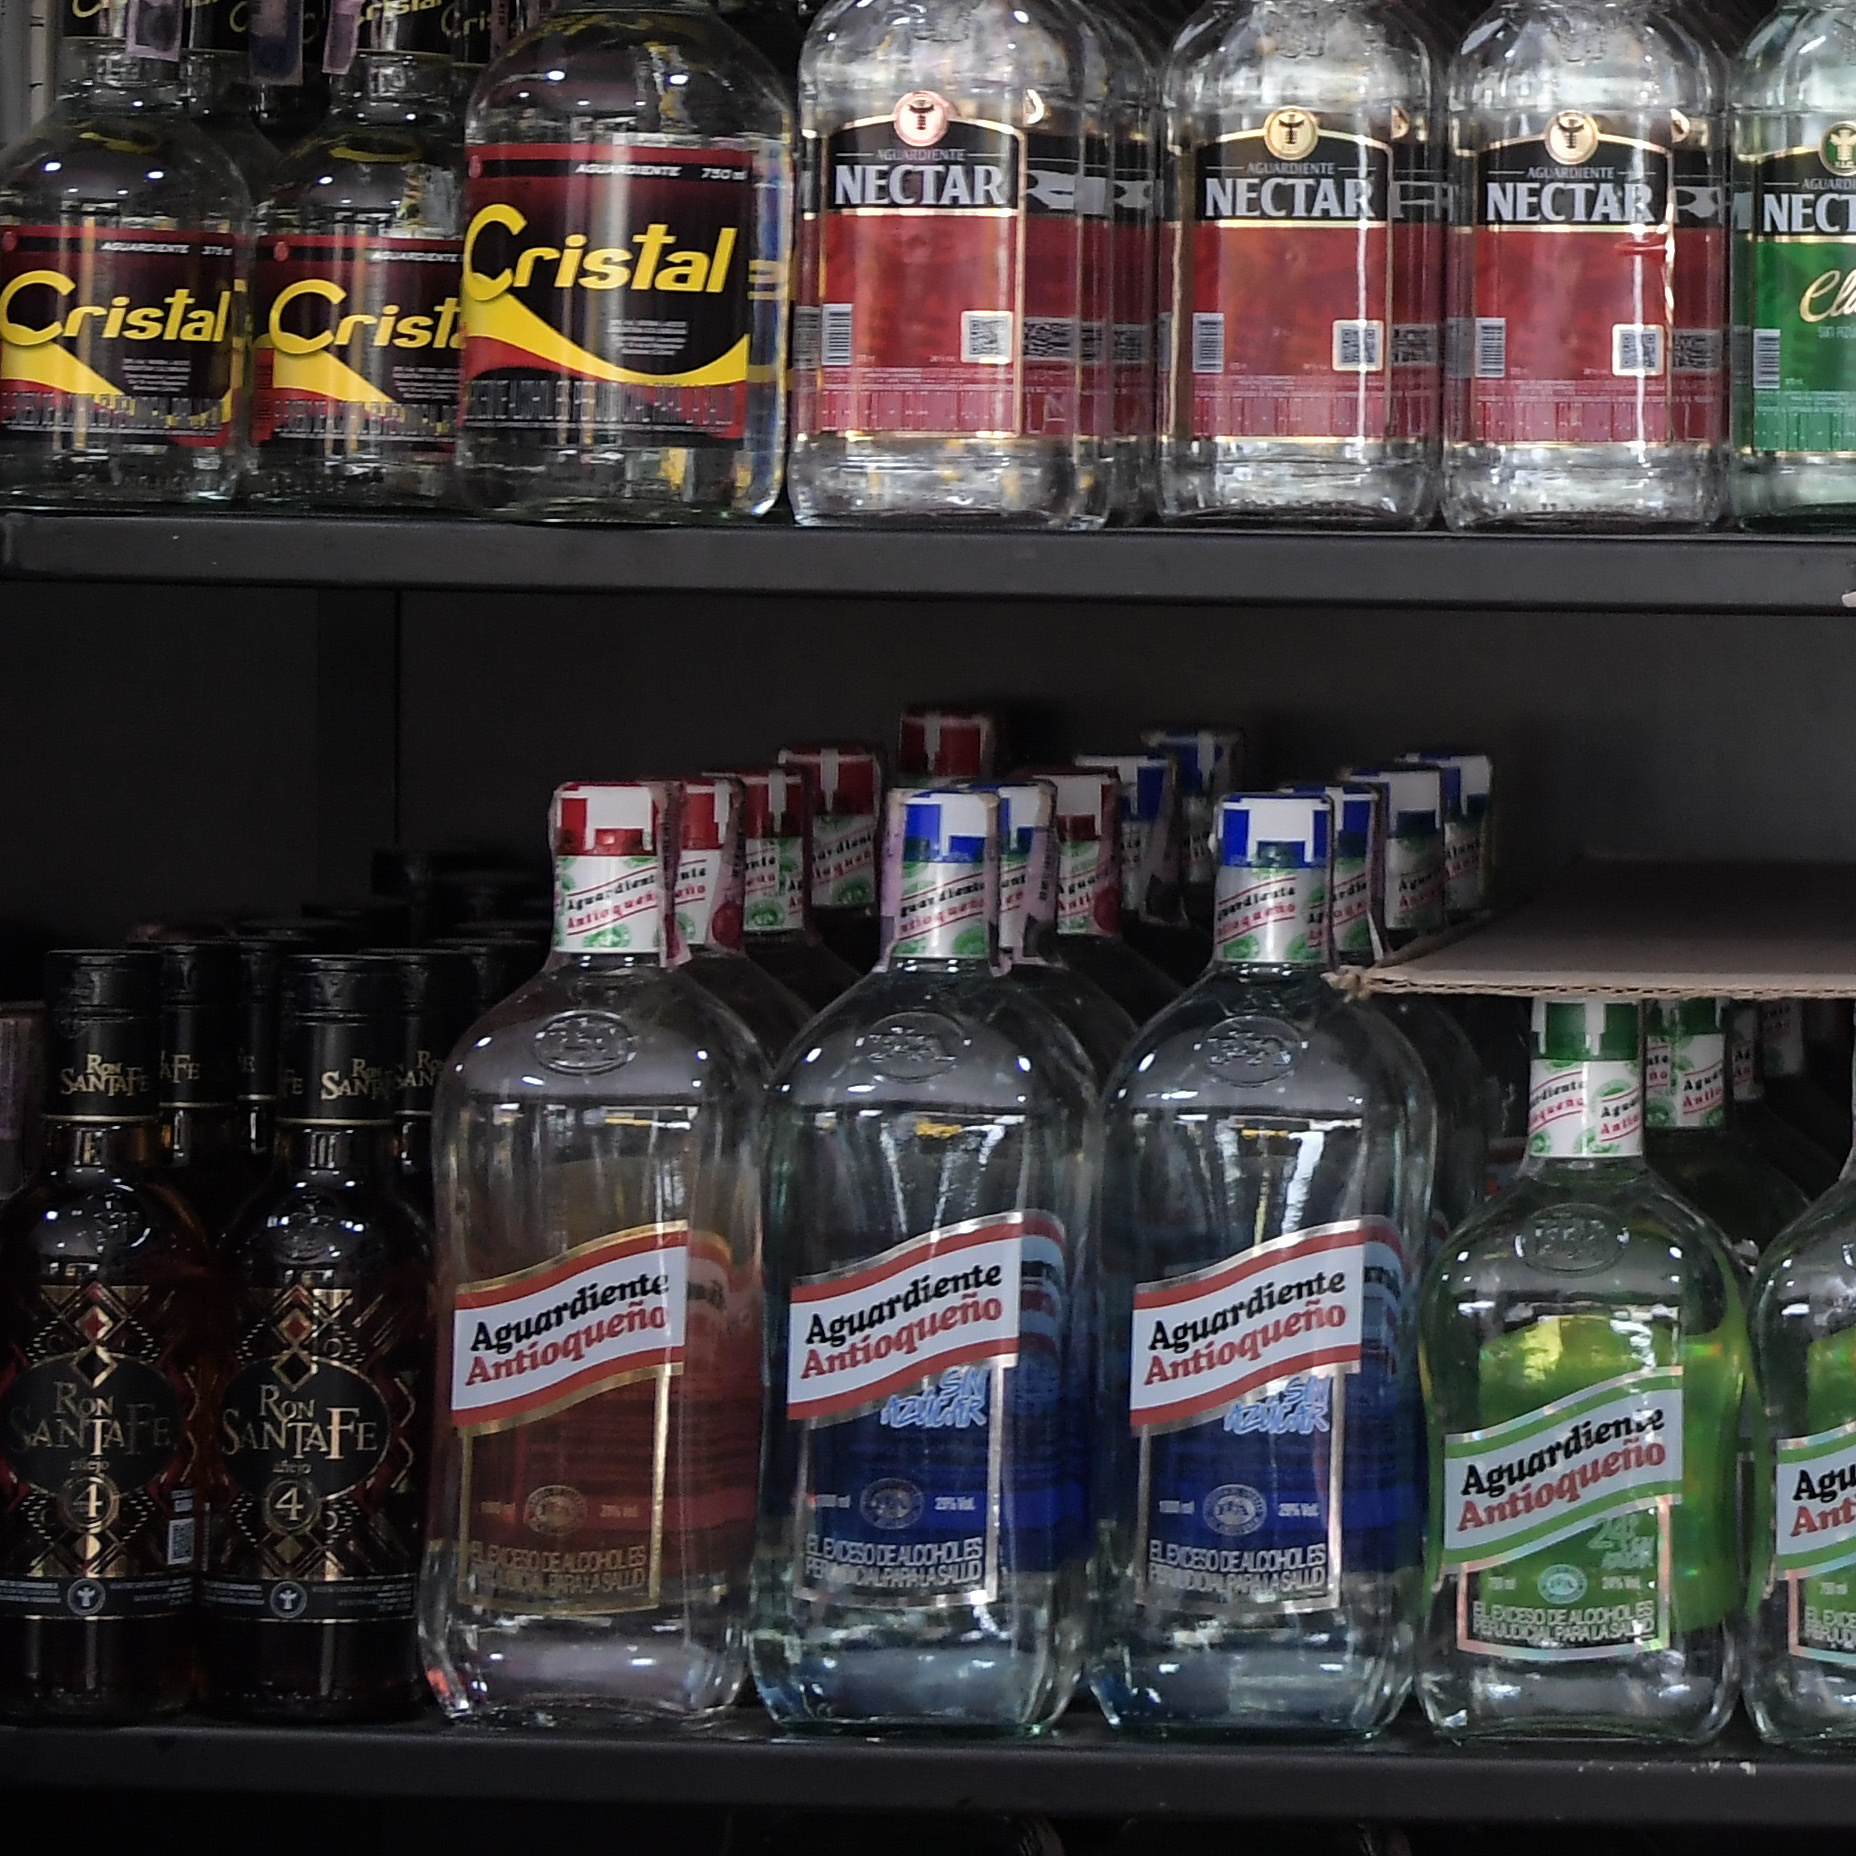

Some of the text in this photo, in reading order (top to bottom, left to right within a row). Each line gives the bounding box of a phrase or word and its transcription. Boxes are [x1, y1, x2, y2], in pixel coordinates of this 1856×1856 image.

[573, 162, 735, 182] AGUARDIENTE 750
[876, 148, 967, 162] AGUARDIENTE
[1246, 161, 1336, 176] AGUARDIENTE
[1526, 166, 1615, 181] AGUARDIENTE
[834, 164, 1002, 207] NECTAR
[1204, 176, 1375, 219] NECTAR
[1485, 182, 1657, 223] NECTAR
[101, 241, 190, 256] AGUARDIENTE
[462, 202, 738, 302] Cristal
[1, 270, 231, 347] Cristal
[268, 278, 464, 355] Crist
[470, 1273, 670, 1354] Aguardiente
[800, 1290, 1004, 1379] Antioqueño
[805, 1262, 1003, 1348] Aguardiente
[1147, 1268, 1345, 1353] Aguardiente
[465, 1297, 670, 1386] Antioqueño
[1142, 1299, 1346, 1385] Antioqueño
[939, 1366, 988, 1396] SIN
[1461, 1403, 1665, 1499] Aguardiente
[75, 1483, 103, 1518] 4
[274, 1486, 304, 1521] 4
[1456, 1436, 1667, 1531] Antioqueño
